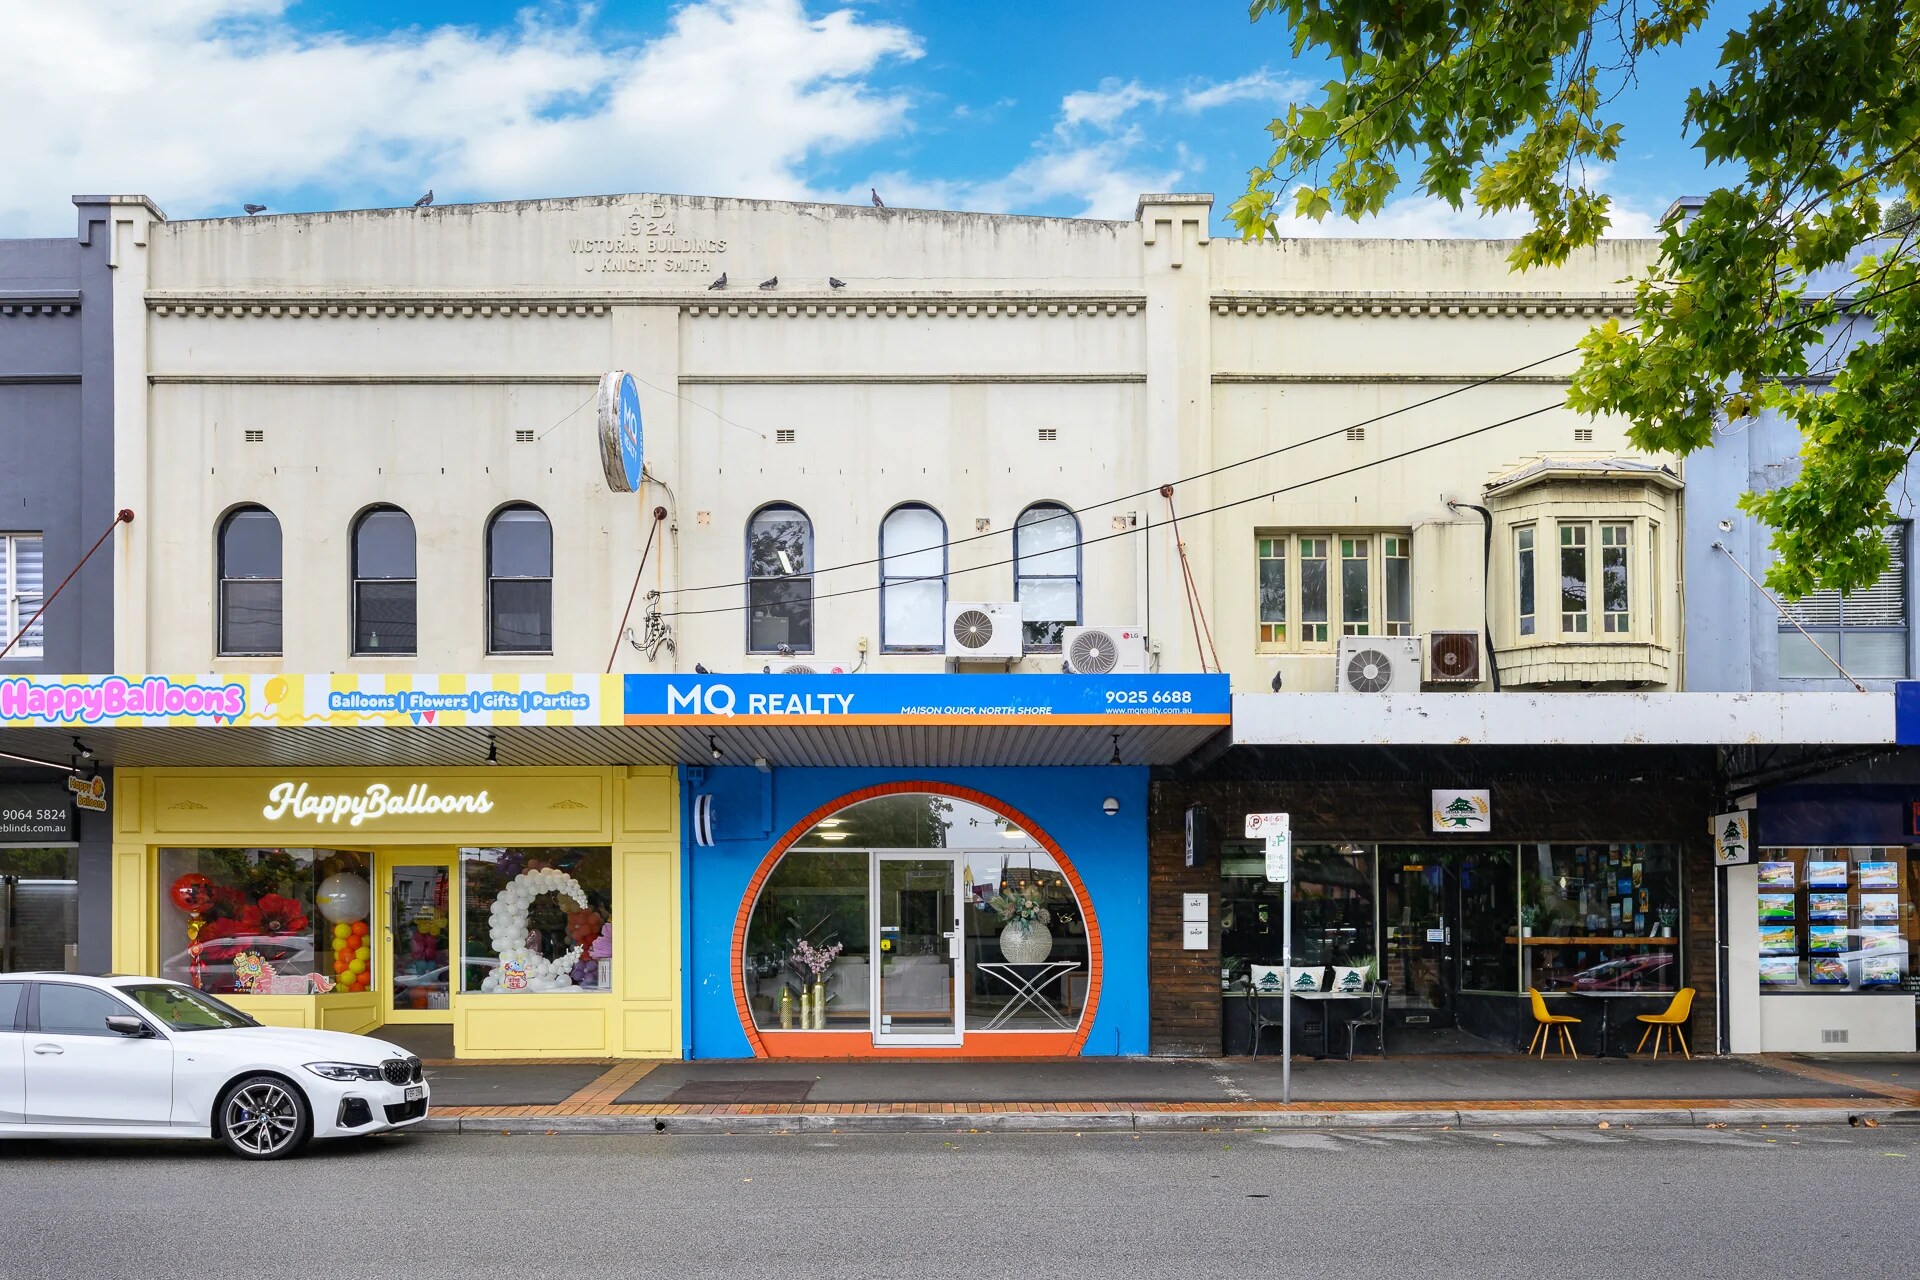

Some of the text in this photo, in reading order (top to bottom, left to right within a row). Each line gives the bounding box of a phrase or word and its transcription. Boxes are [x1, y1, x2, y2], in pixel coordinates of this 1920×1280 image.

[622, 222, 676, 237] 1924
[569, 239, 727, 253] VICTORIA BUILDINGS
[585, 258, 711, 272] J KNIGHT SMITH
[623, 397, 638, 441] MQ
[2, 680, 241, 718] HappyBalloons
[331, 694, 587, 708] Balloons Flowers Gifts Parties
[667, 684, 854, 718] MQ REALTY
[1105, 691, 1192, 704] 9025 6688
[900, 706, 1053, 714] MAISON QUICK NORTH SHORE
[1105, 707, 1193, 716] www.mqrealty.com.au
[70, 780, 92, 794] Happy
[263, 782, 494, 827] HappyBalloons
[3, 809, 66, 820] 9064 5824
